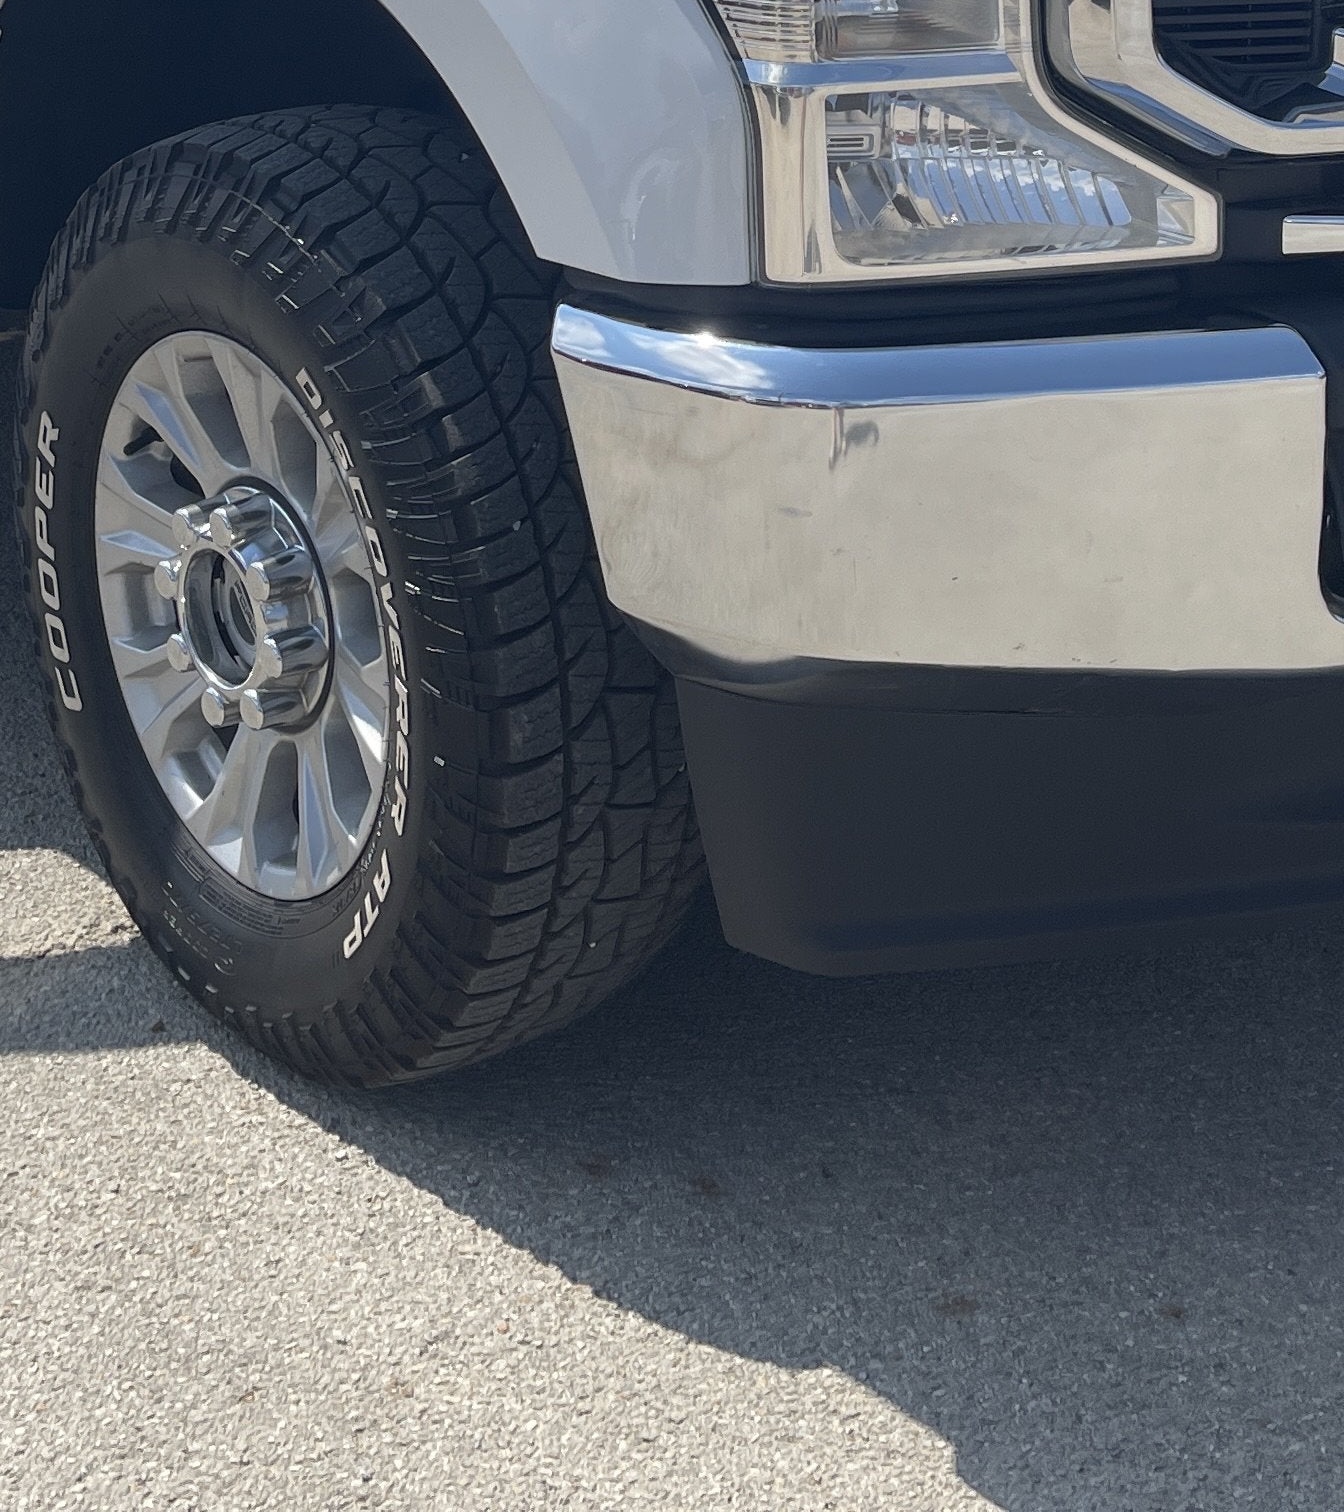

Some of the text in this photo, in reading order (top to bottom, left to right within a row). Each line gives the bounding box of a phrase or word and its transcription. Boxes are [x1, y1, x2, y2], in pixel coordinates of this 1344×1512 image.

[34, 410, 83, 712] COOPER
[296, 368, 409, 837] DISCOVERER
[343, 849, 391, 959] ATP
